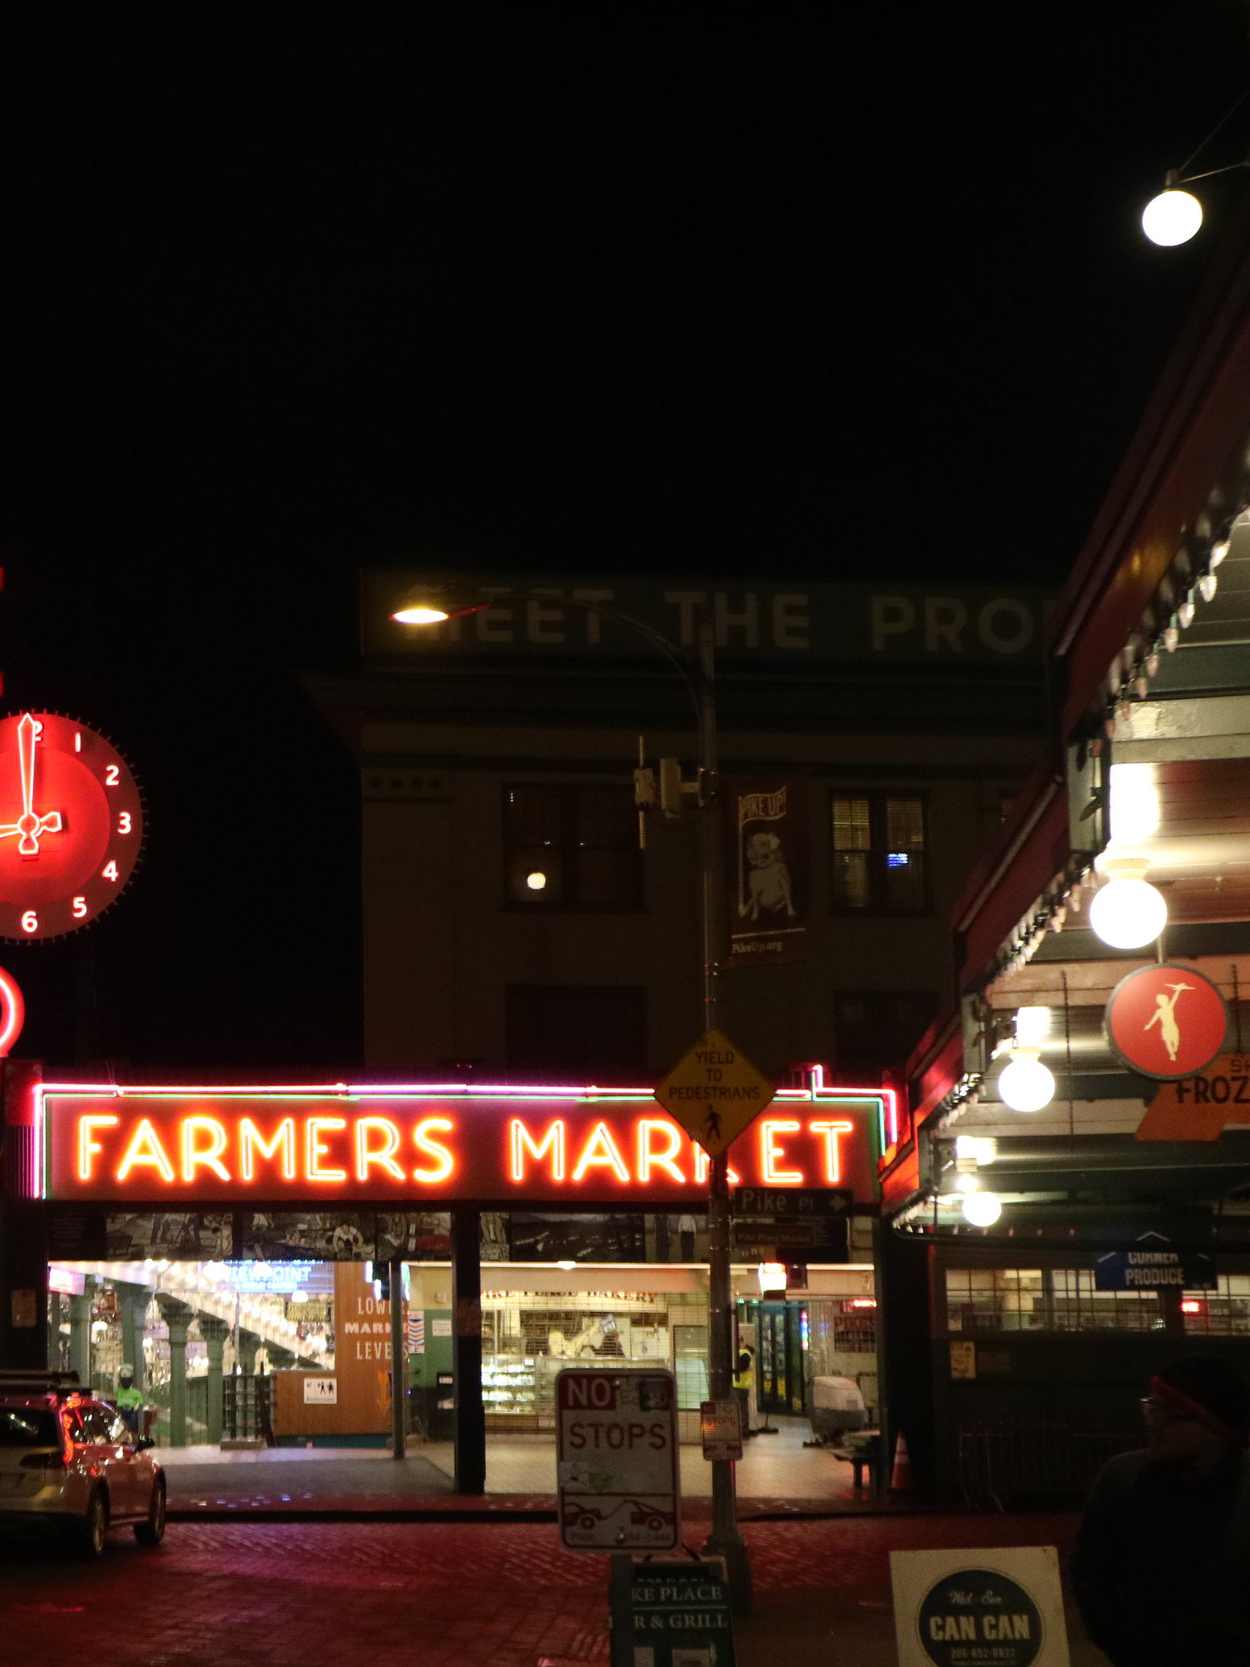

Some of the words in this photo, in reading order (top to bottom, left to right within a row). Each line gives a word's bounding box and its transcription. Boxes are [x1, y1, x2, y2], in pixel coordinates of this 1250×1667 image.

[664, 591, 812, 649] THE
[105, 765, 120, 786] 2
[117, 811, 132, 834] 3
[101, 859, 119, 882] 4
[72, 896, 88, 918] 5
[21, 910, 38, 933] 6
[694, 1050, 735, 1065] YIELD
[706, 1068, 723, 1082] TO
[669, 1086, 761, 1101] PEDESTRIANS
[78, 1114, 455, 1183] FARMERS
[741, 1188, 788, 1213] Pike
[798, 1196, 814, 1212] Pl
[1124, 1267, 1186, 1286] PRODUCE
[356, 1340, 409, 1360] LEVES
[567, 1377, 611, 1408] NO
[569, 1422, 666, 1450] STOPS
[659, 1585, 724, 1601] PLACE
[649, 1613, 664, 1630] &
[668, 1612, 729, 1629] GRILL
[929, 1614, 977, 1641] CAN
[981, 1613, 1031, 1640] CAN
